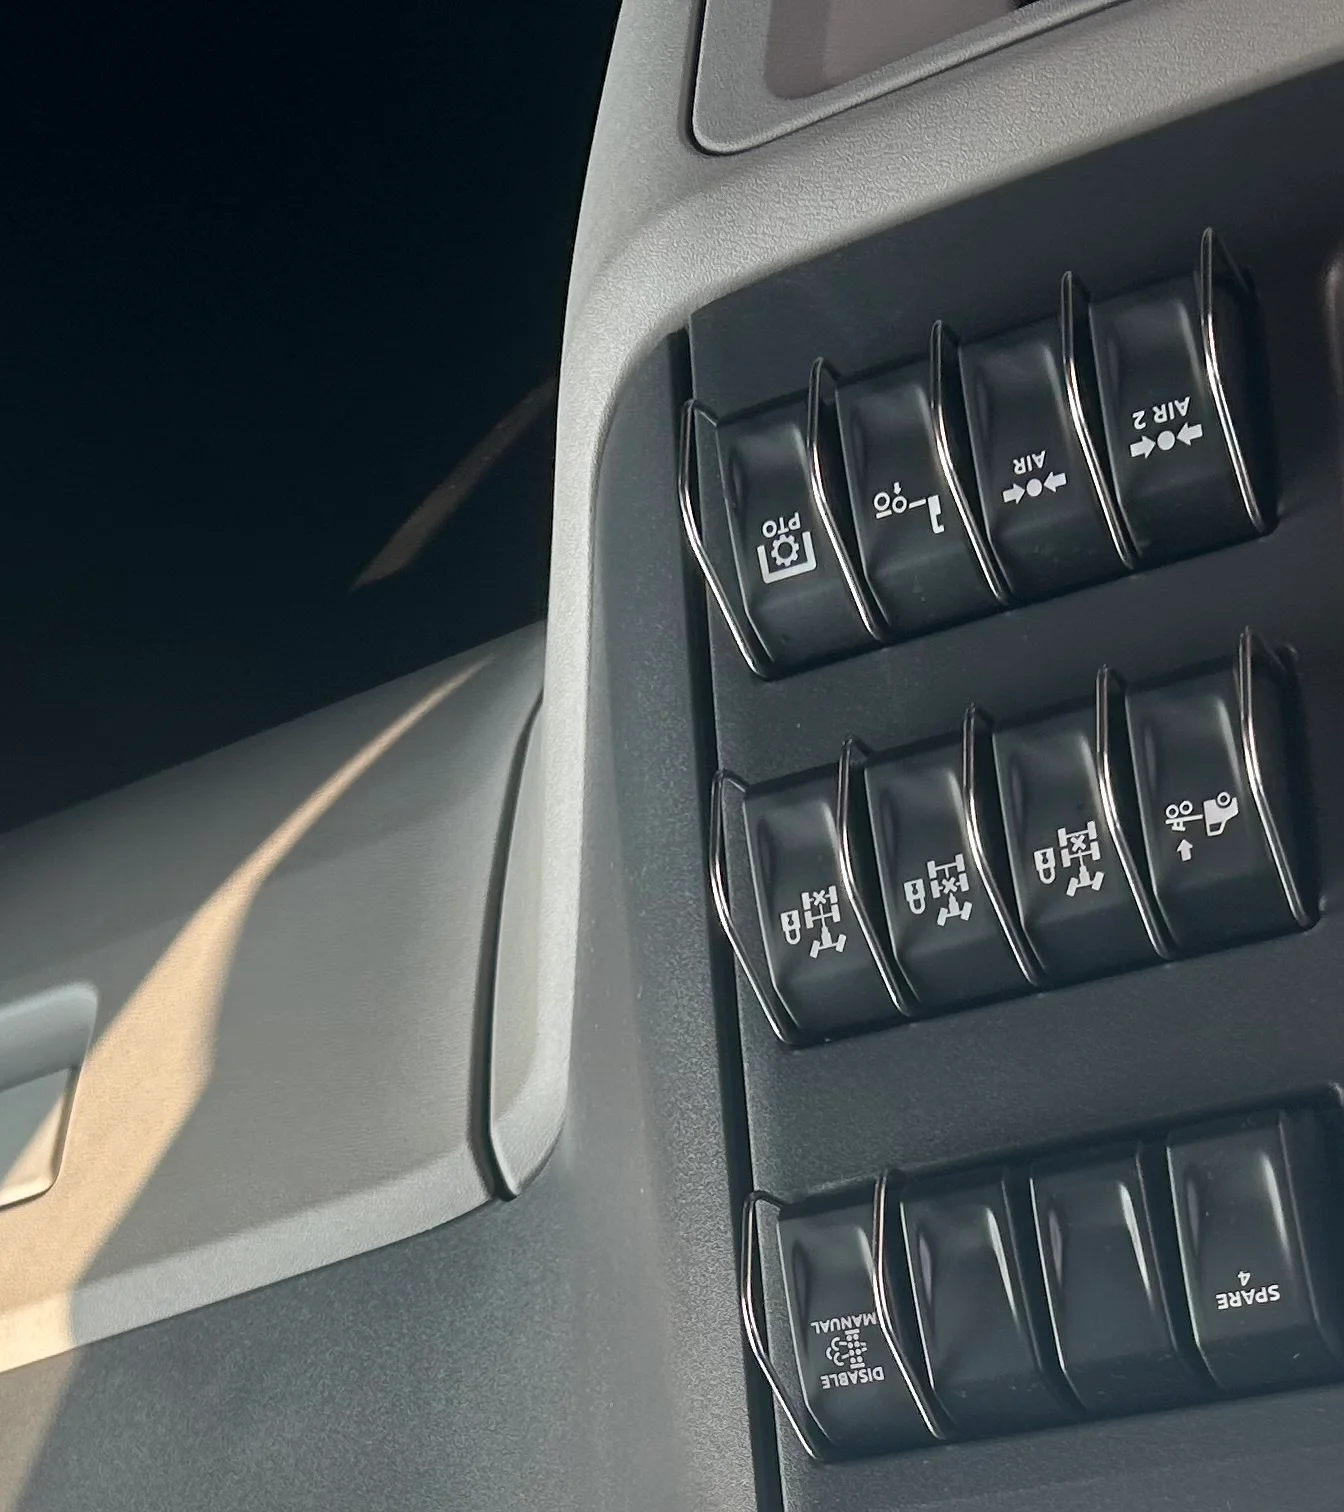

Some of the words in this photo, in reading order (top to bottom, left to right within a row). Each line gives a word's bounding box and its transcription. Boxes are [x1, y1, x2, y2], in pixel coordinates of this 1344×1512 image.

[1131, 408, 1147, 430] 2
[1151, 396, 1191, 425] AIR
[1011, 449, 1047, 475] AIR
[762, 511, 802, 539] PTO
[1237, 1269, 1251, 1287] 4
[1215, 1283, 1281, 1311] SPARE
[810, 1312, 878, 1335] MANUAL
[820, 1365, 885, 1389] DISABLE
